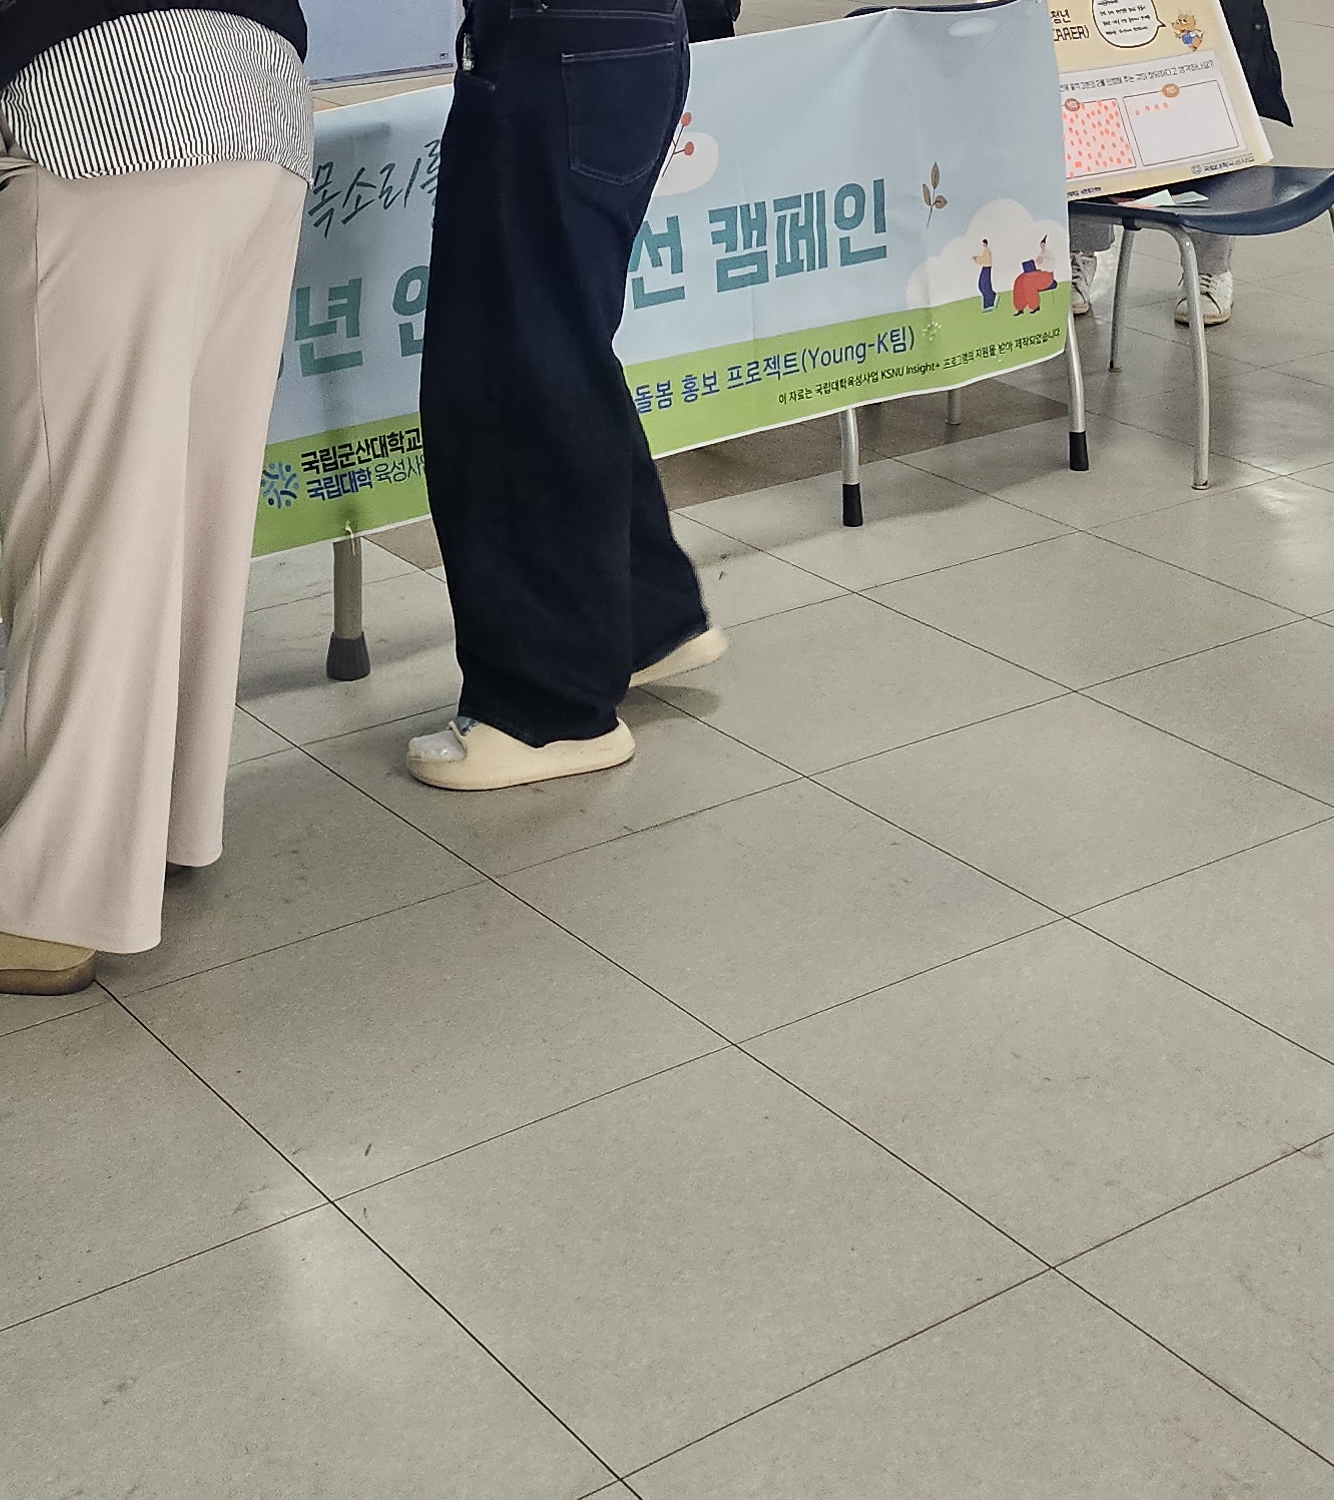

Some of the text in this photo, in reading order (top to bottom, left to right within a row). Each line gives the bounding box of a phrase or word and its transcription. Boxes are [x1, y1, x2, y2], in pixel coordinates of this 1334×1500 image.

[708, 178, 887, 293] 캠페인
[681, 370, 721, 404] 홍보
[778, 392, 788, 405] 이
[788, 387, 813, 403] 자료는
[881, 365, 905, 380] KSNU
[301, 427, 424, 475] 국립군산대학교
[306, 467, 374, 501] 국립대학
